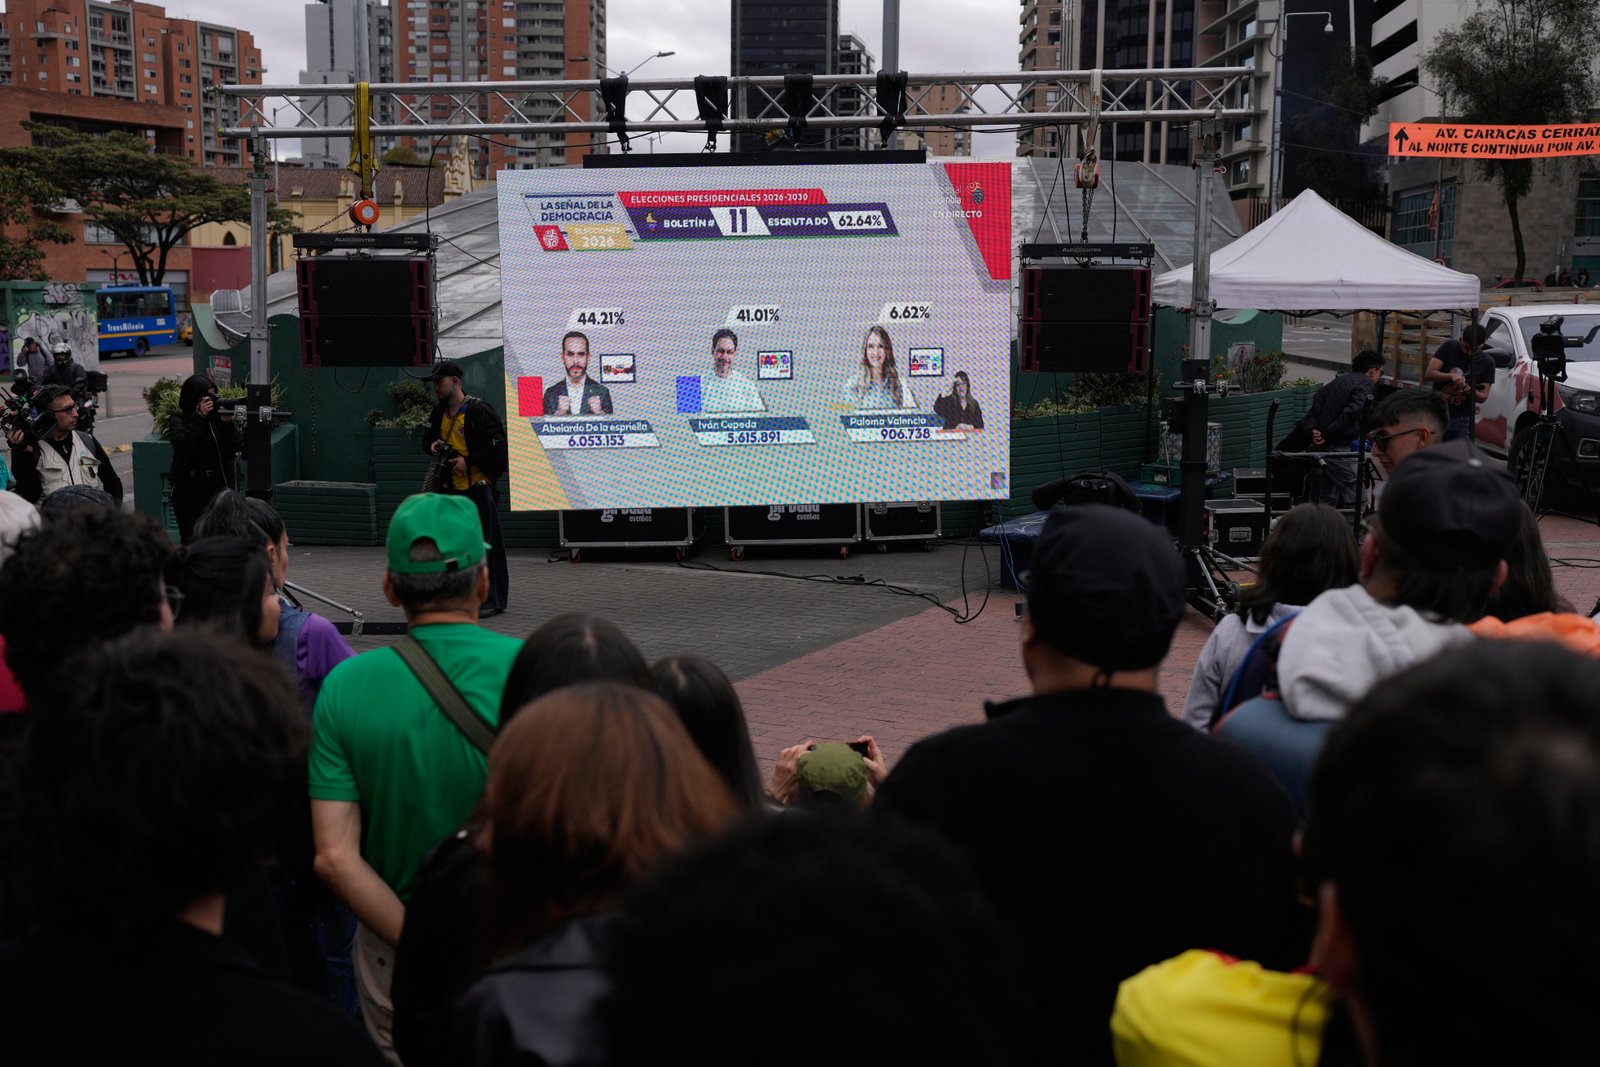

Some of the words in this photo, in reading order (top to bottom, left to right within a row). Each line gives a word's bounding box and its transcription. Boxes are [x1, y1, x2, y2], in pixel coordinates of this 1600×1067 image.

[1435, 128, 1458, 139] AV.
[1463, 129, 1537, 140] CARACAS
[1408, 142, 1423, 153] AL
[1427, 142, 1468, 154] NORTE
[1471, 143, 1544, 155] CONTINUAR
[1547, 141, 1573, 152] POR
[1576, 140, 1594, 151] AV.
[540, 202, 553, 210] LA
[554, 199, 586, 210] SEÑAL
[587, 201, 599, 209] DE
[601, 200, 613, 209] LA
[631, 194, 685, 204] ELECCIONES
[687, 193, 761, 203] PRESIDENCIALES
[763, 193, 809, 202] 2026-2030
[541, 211, 613, 221] DEMOCRACIA
[948, 210, 983, 218] DIRECTO
[663, 216, 707, 228] BOLETÍN
[729, 208, 747, 233] 11
[768, 217, 829, 227] ESCRUTADO
[838, 213, 882, 227] 62.64%
[582, 235, 615, 248] 2026
[577, 311, 625, 325] 44.21%
[736, 308, 780, 322] 41.01%
[889, 305, 930, 319] 6.62%
[107, 322, 145, 332] TransMilenio
[698, 419, 719, 429] Iván
[720, 420, 757, 431] Cepeda
[850, 417, 885, 426] Paloma
[887, 416, 927, 425] Valencia
[542, 424, 585, 433] Abelardo
[585, 423, 599, 432] De
[600, 423, 609, 432] la
[609, 422, 648, 433] espriella
[727, 431, 781, 444] 5.615.891
[880, 428, 931, 440] 906.738
[568, 434, 625, 447] 6.053.153
